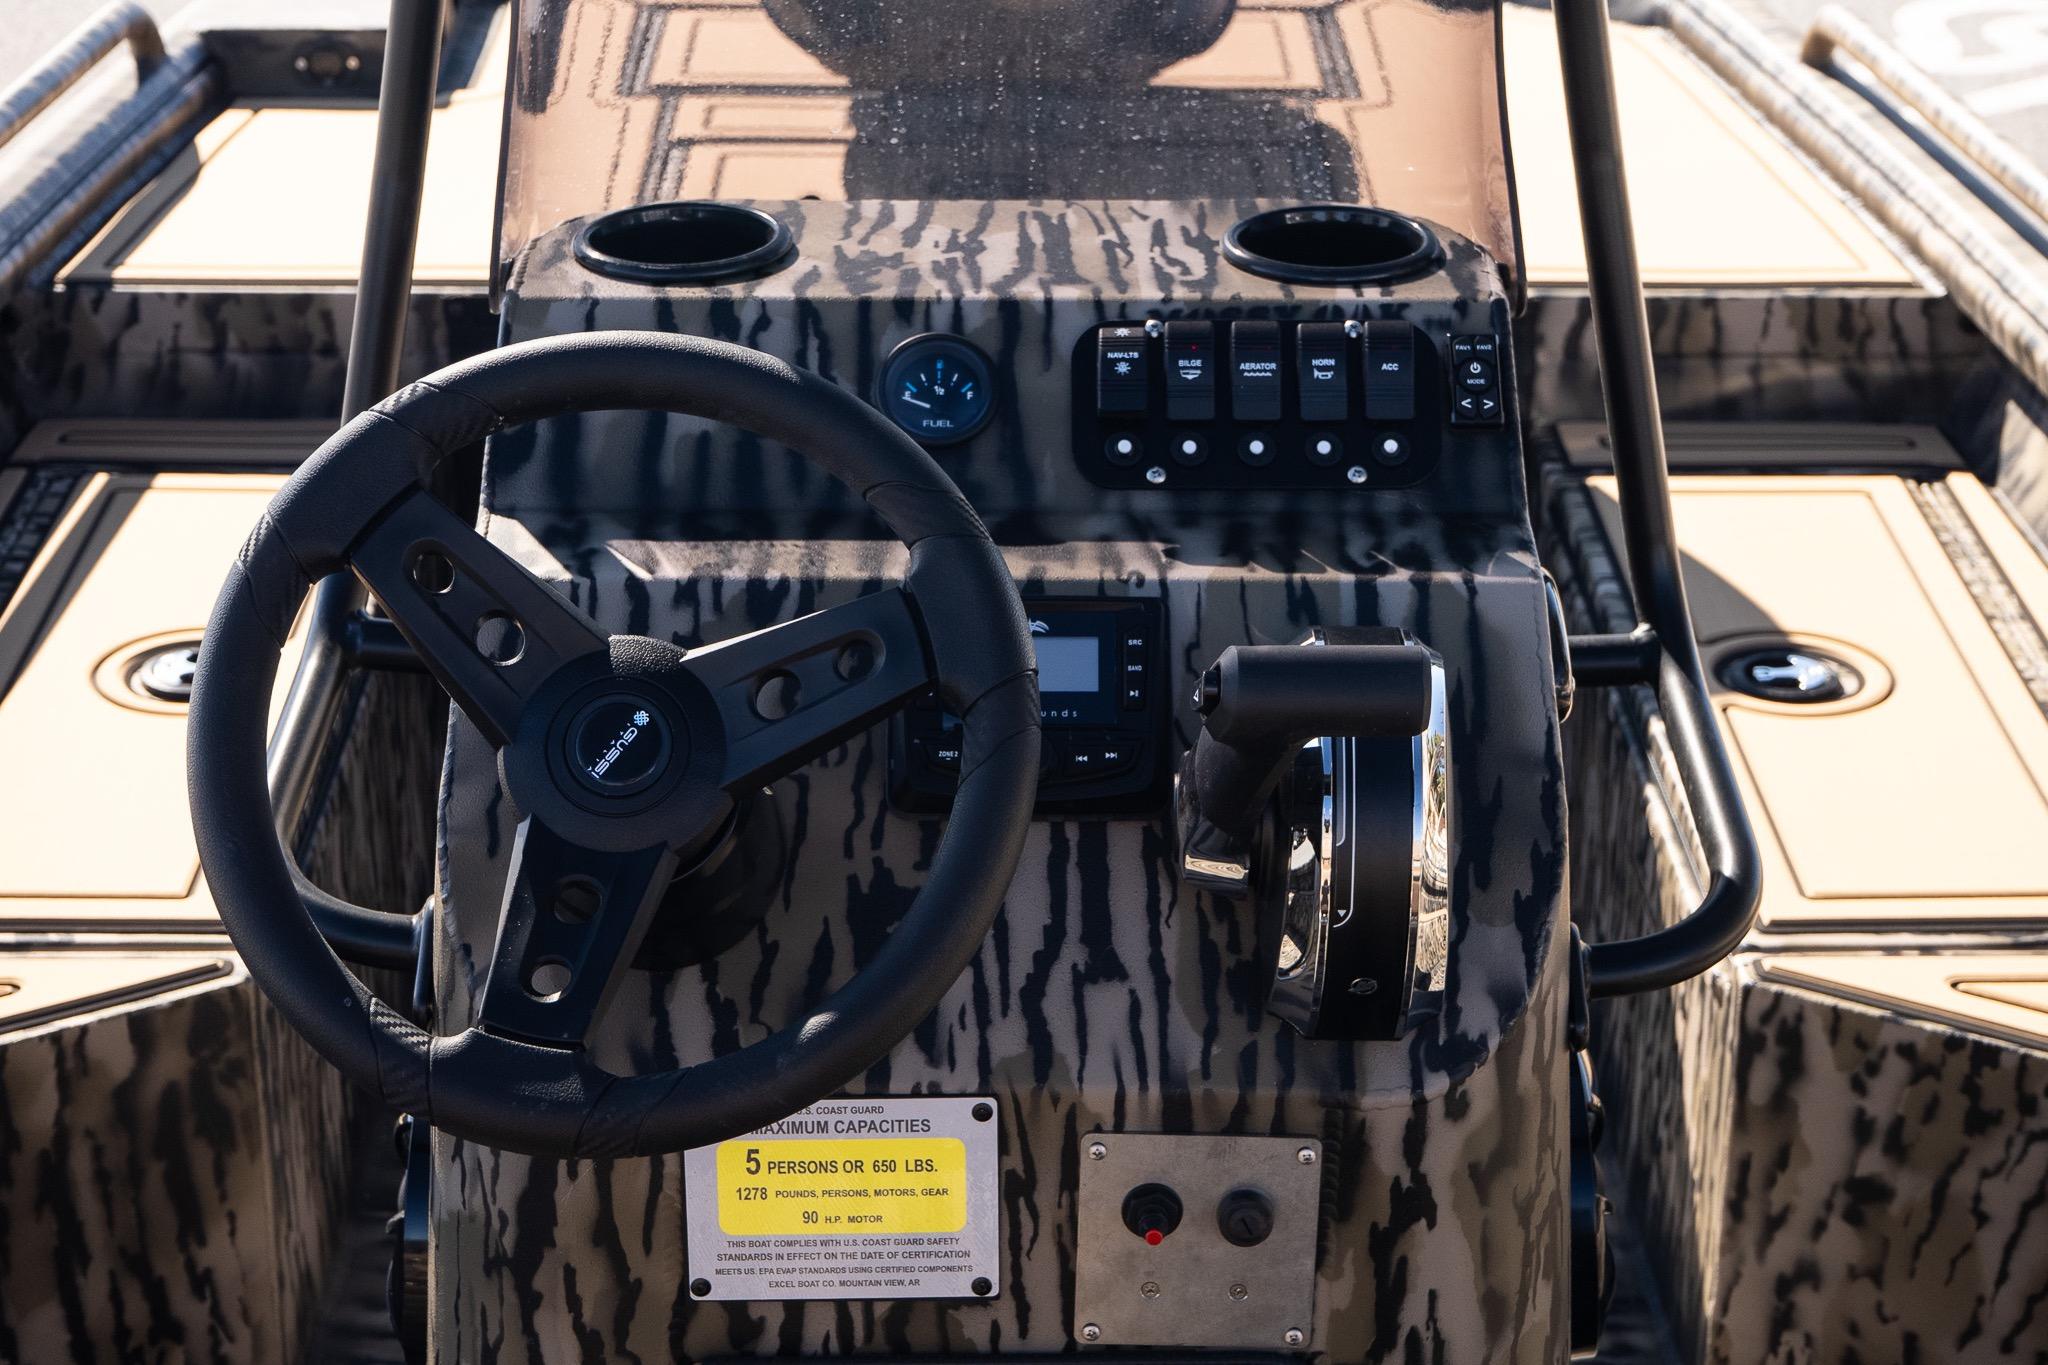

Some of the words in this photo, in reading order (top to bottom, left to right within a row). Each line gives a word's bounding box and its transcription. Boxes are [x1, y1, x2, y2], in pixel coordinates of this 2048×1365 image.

[1178, 359, 1202, 367] BILGE
[1240, 362, 1277, 370] AERATOR
[1381, 363, 1399, 371] ACC
[967, 391, 973, 400] F
[922, 419, 954, 427] FUEL
[1040, 709, 1078, 718] unds
[797, 1106, 814, 1115] .S.
[816, 1106, 848, 1115] COAST
[851, 1105, 885, 1114] GUARD
[834, 1118, 931, 1134] CAPACITIES
[745, 1148, 761, 1176] 5
[767, 1160, 839, 1174] PERSONS
[842, 1160, 865, 1174] OR
[872, 1159, 897, 1173] 650
[905, 1159, 939, 1173] LBS.
[736, 1187, 768, 1201] 1278
[775, 1190, 819, 1199] POUNDS,
[822, 1189, 872, 1198] PERSONS,
[874, 1188, 919, 1197] MOTORS,
[921, 1188, 949, 1196] GEAR
[802, 1210, 819, 1224] 90
[847, 1215, 883, 1223] MOTOR
[748, 1240, 771, 1248] BOAT
[820, 1239, 841, 1247] WITH
[862, 1238, 891, 1246] COAST
[894, 1238, 925, 1246] GUARD
[926, 1237, 960, 1245] SAFETY
[716, 1253, 773, 1261] STANDARDS
[786, 1252, 821, 1260] EFFECT
[823, 1252, 838, 1260] ON
[840, 1252, 858, 1260] THE
[860, 1251, 885, 1259] DATE
[886, 1251, 900, 1259] OF
[901, 1250, 971, 1259] CERTIFICATION
[759, 1267, 775, 1275] EPA
[798, 1266, 846, 1274] STANDARDS
[874, 1265, 916, 1273] CERTIFIED
[917, 1265, 973, 1273] COMPONENTS
[768, 1280, 796, 1288] EXCEL
[839, 1279, 882, 1287] MOUNTAIN
